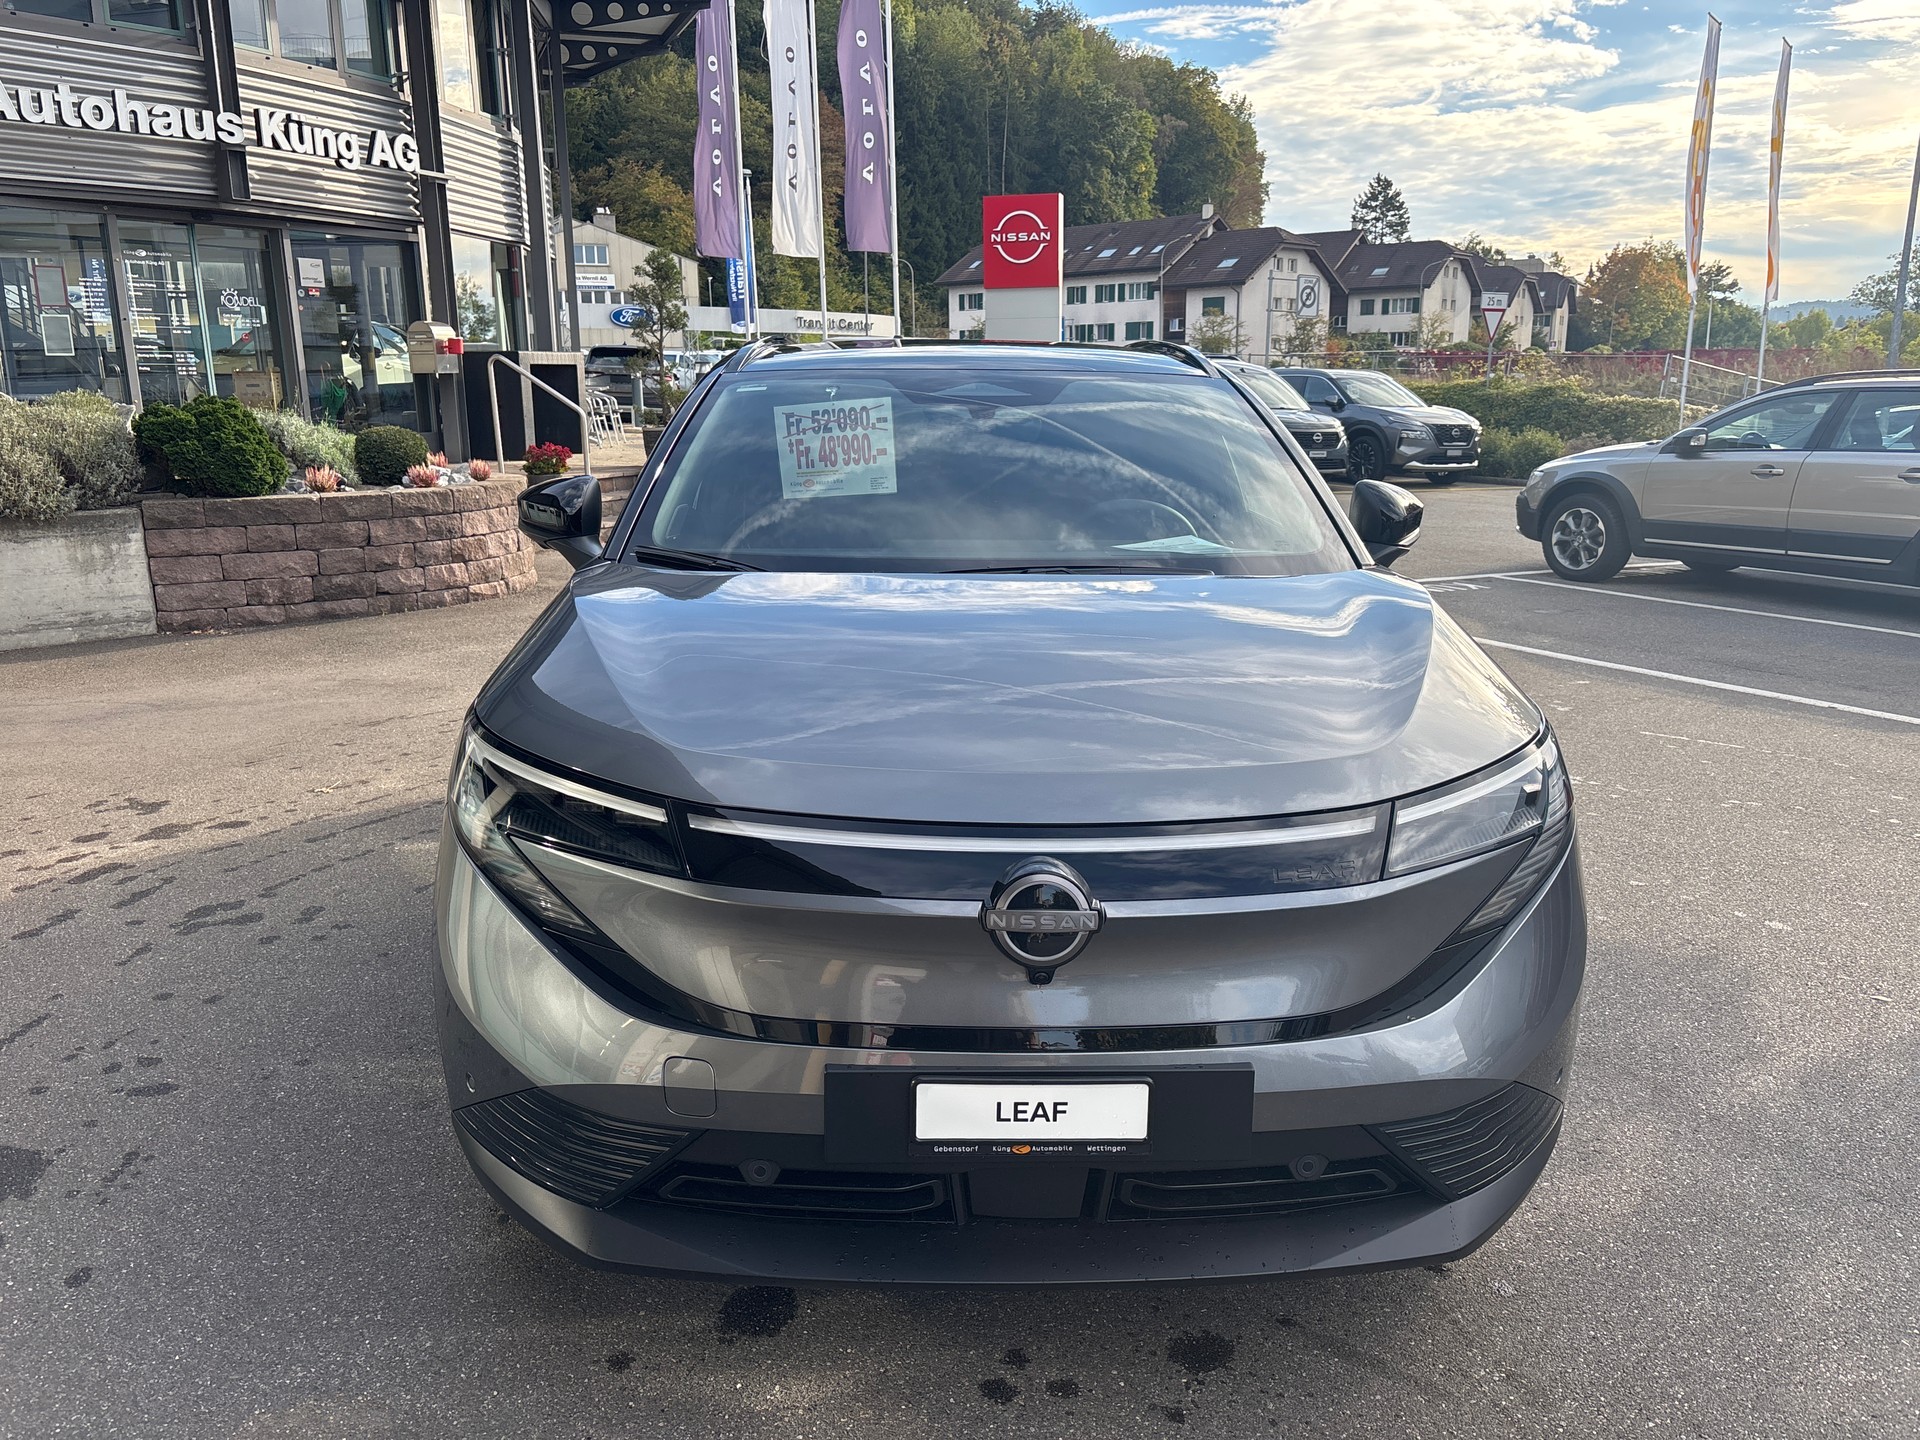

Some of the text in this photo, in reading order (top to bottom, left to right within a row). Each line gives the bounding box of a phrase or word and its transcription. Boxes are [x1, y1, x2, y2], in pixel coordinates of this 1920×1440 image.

[254, 108, 361, 171] Küng
[366, 129, 420, 173] AG
[990, 231, 1051, 243] NISSAN
[1487, 296, 1495, 306] 25
[795, 316, 836, 330] Tranit
[785, 412, 807, 436] Fr.
[1273, 860, 1356, 884] LEAF
[989, 913, 1097, 930] NISSAN
[996, 1101, 1069, 1122] LEAF
[933, 1144, 1127, 1153] Gebenstorf Küng Automobile Wettingen
